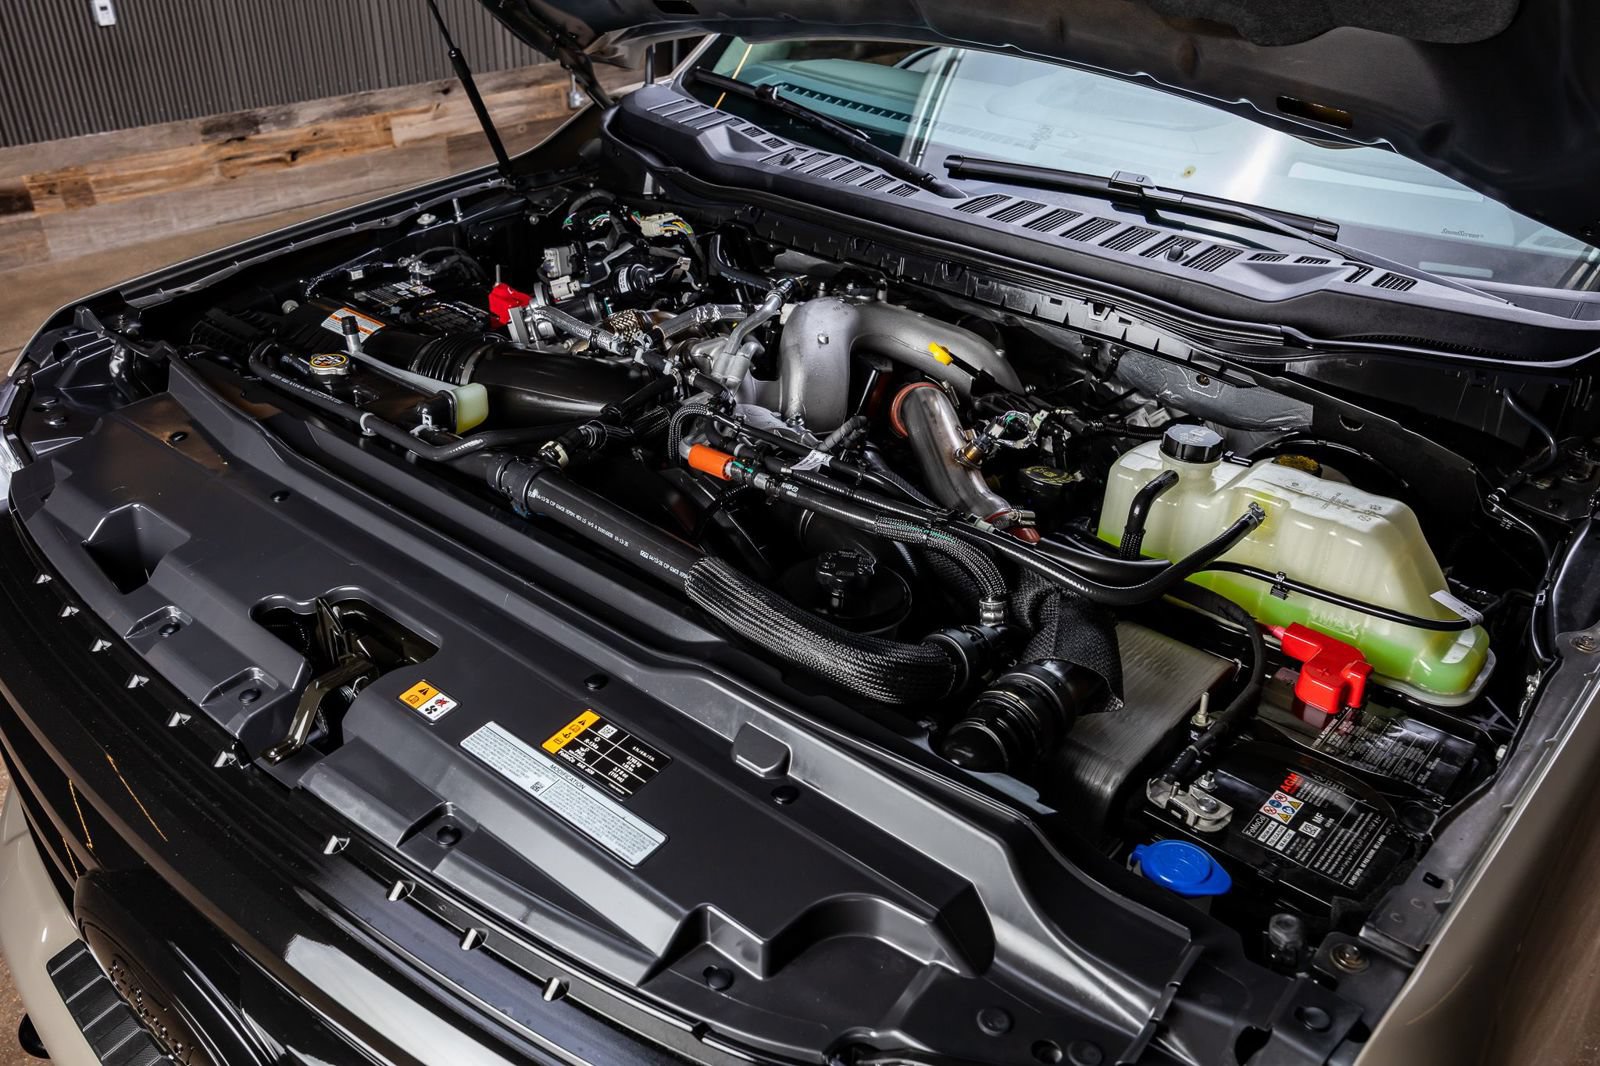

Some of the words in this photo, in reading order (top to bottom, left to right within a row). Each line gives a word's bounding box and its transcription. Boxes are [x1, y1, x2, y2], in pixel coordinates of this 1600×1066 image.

[549, 764, 586, 790] MODIFICATION
[1280, 772, 1298, 793] AGM
[1245, 816, 1266, 836] FoMoCo
